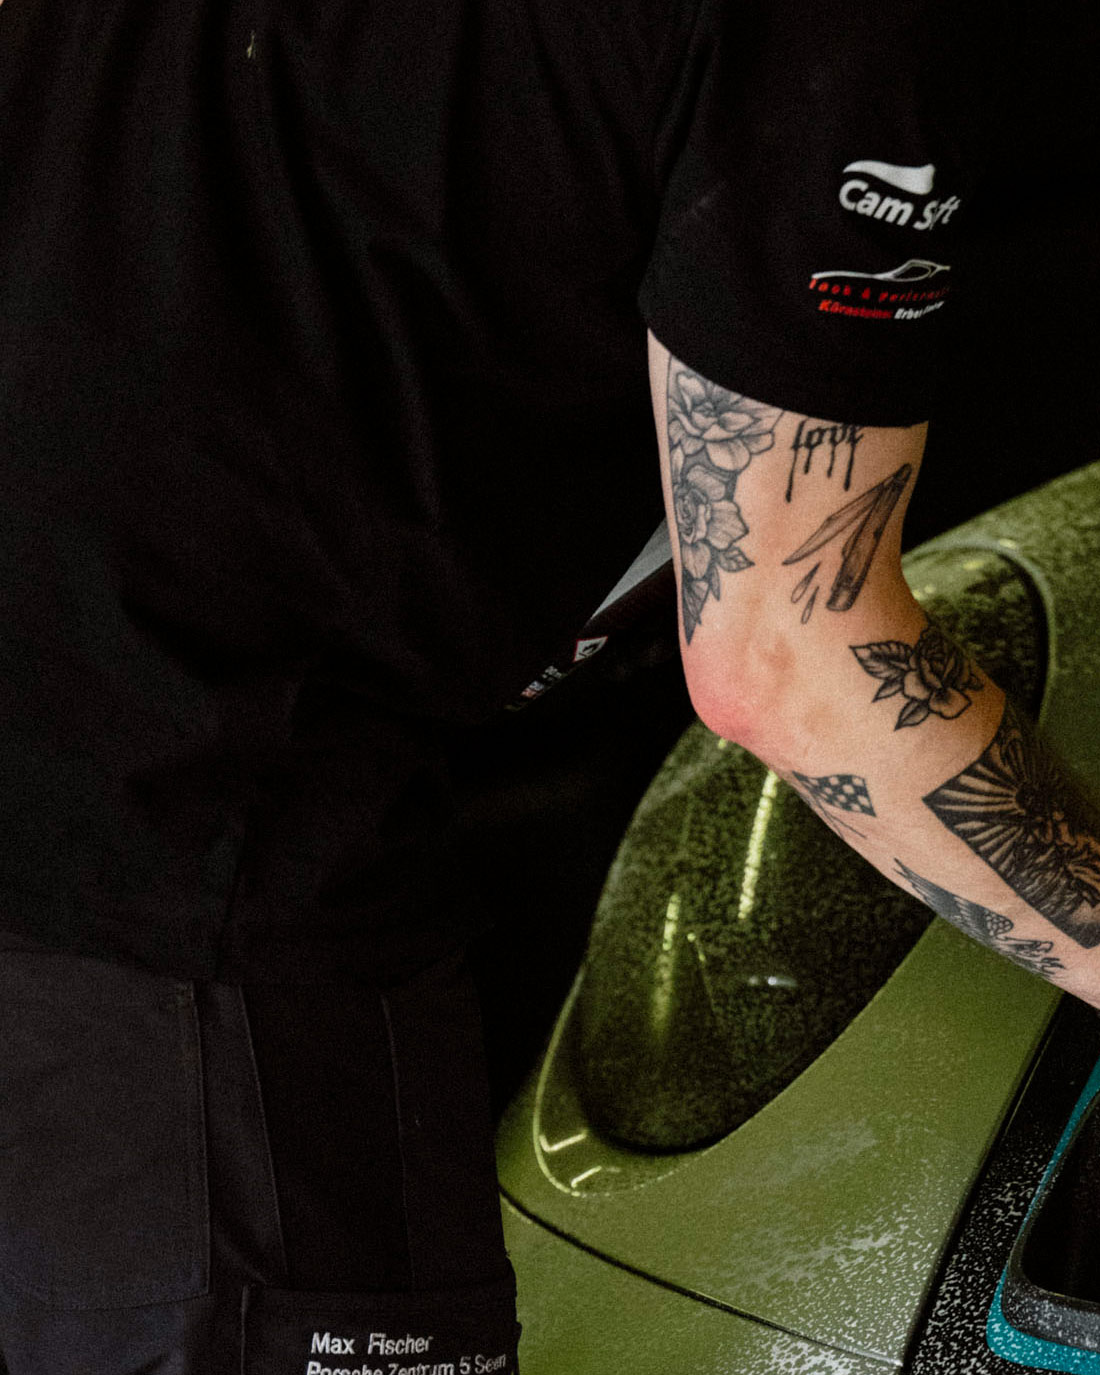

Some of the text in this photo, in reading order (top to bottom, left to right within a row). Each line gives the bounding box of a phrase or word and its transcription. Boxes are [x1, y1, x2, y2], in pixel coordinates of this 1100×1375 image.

[839, 179, 914, 226] Cam
[310, 1332, 434, 1356] Max Fischer
[459, 1356, 471, 1375] 5
